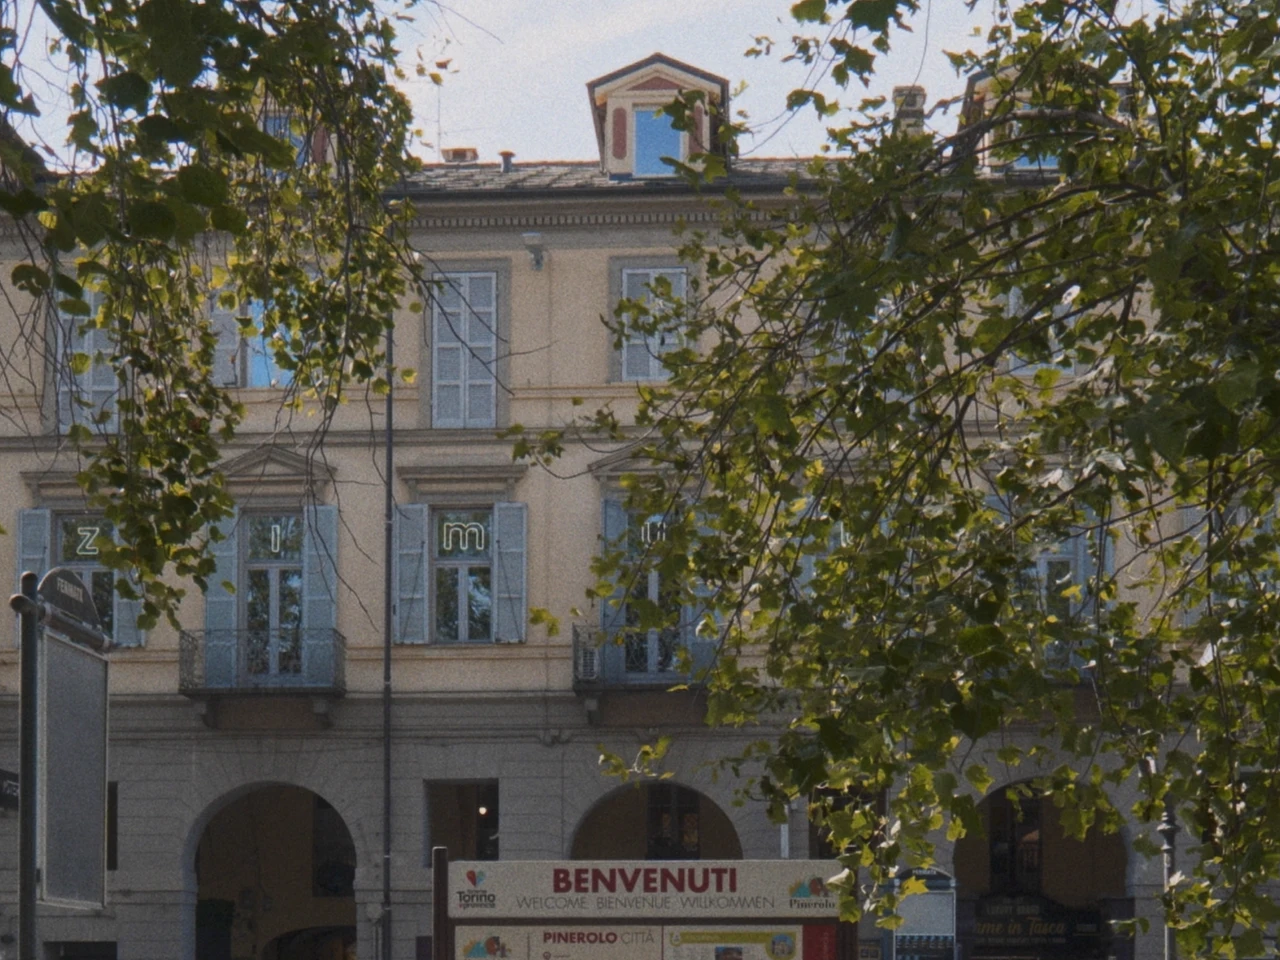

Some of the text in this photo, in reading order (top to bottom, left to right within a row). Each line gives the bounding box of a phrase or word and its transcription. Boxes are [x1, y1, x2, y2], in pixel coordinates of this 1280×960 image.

[552, 867, 737, 893] BENVENUTI
[456, 891, 496, 903] Torino
[516, 896, 775, 910] WELCOME BIENVENUE WILLKOMMEN
[788, 898, 836, 910] Pinerolo
[1007, 919, 1023, 935] in
[1024, 916, 1066, 936] Tasca
[542, 931, 618, 945] PINEROLO
